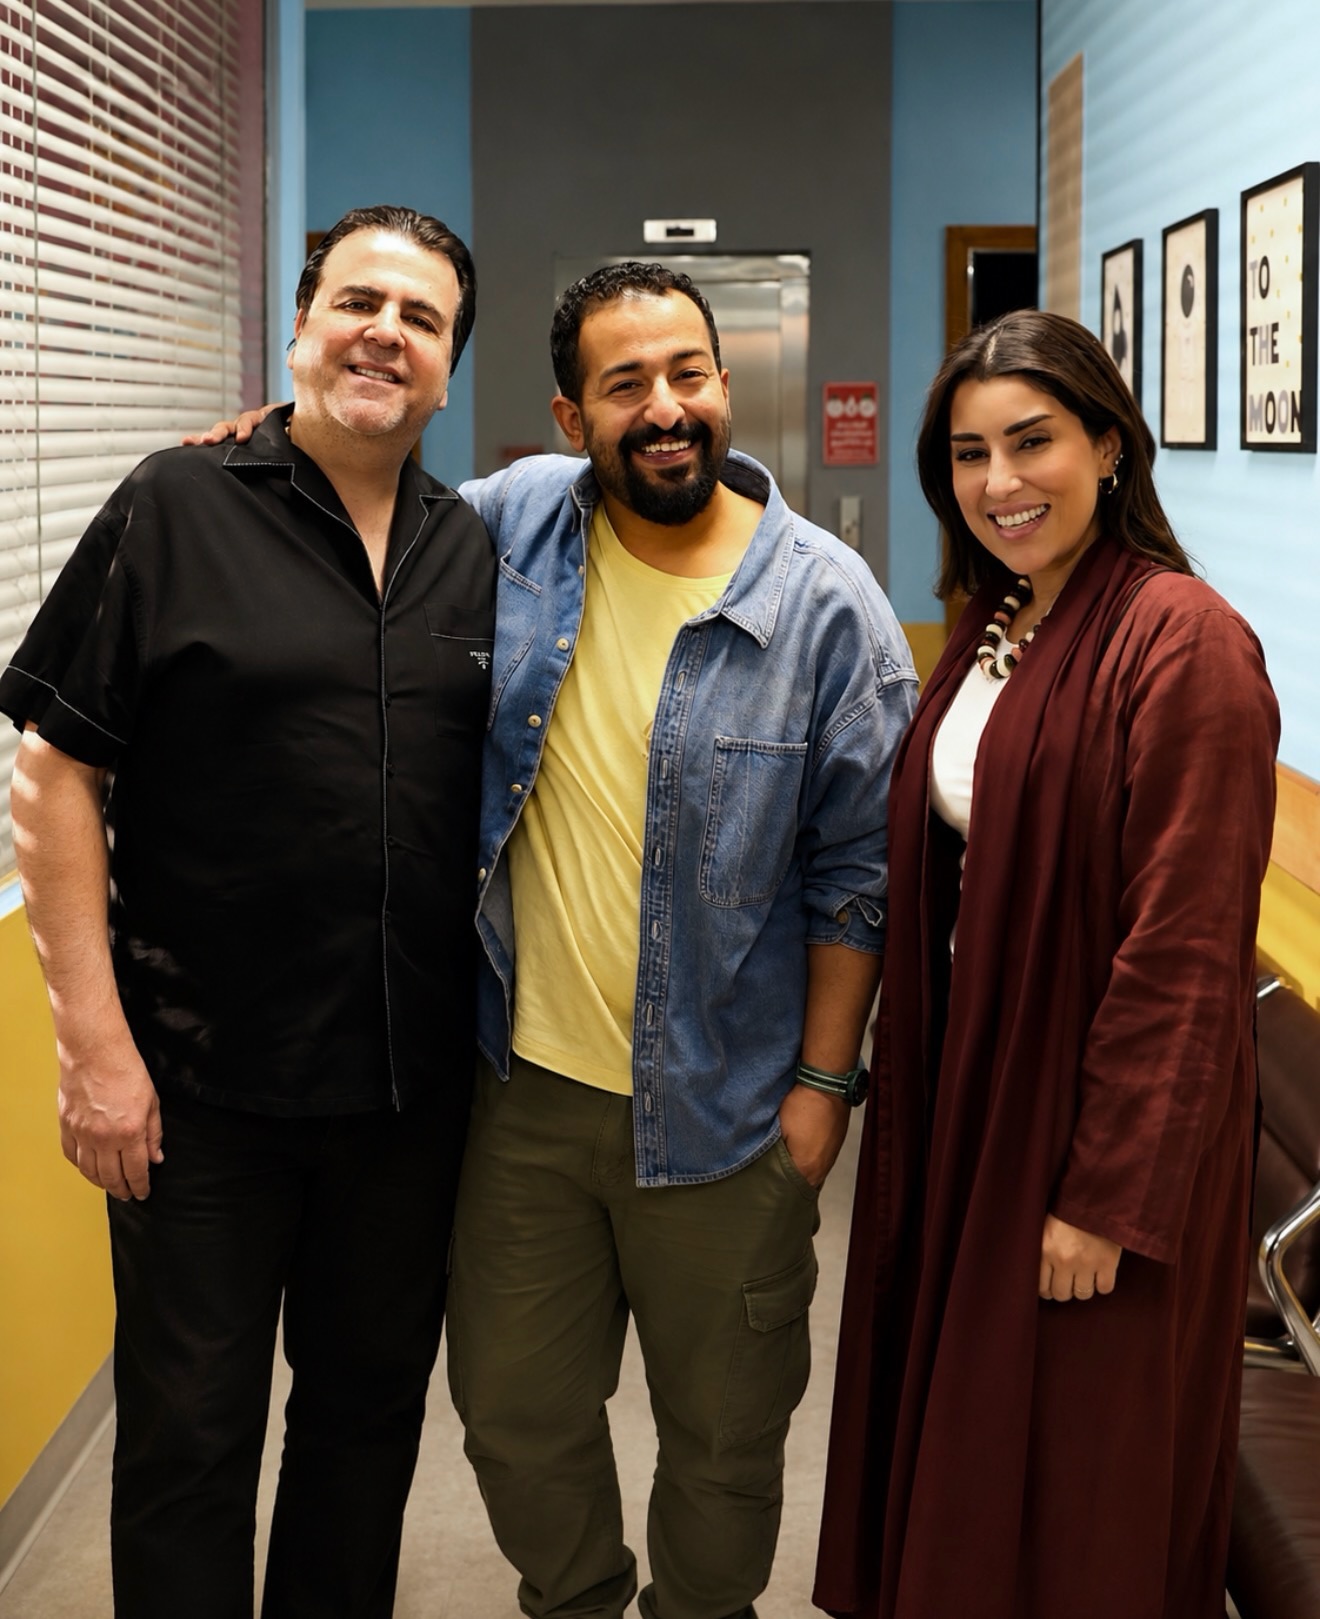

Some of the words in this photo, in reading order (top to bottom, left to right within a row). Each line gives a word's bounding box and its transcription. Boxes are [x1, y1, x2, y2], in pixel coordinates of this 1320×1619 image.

[1249, 255, 1270, 299] TO
[1249, 322, 1279, 366] THE
[1249, 389, 1302, 434] MOON
